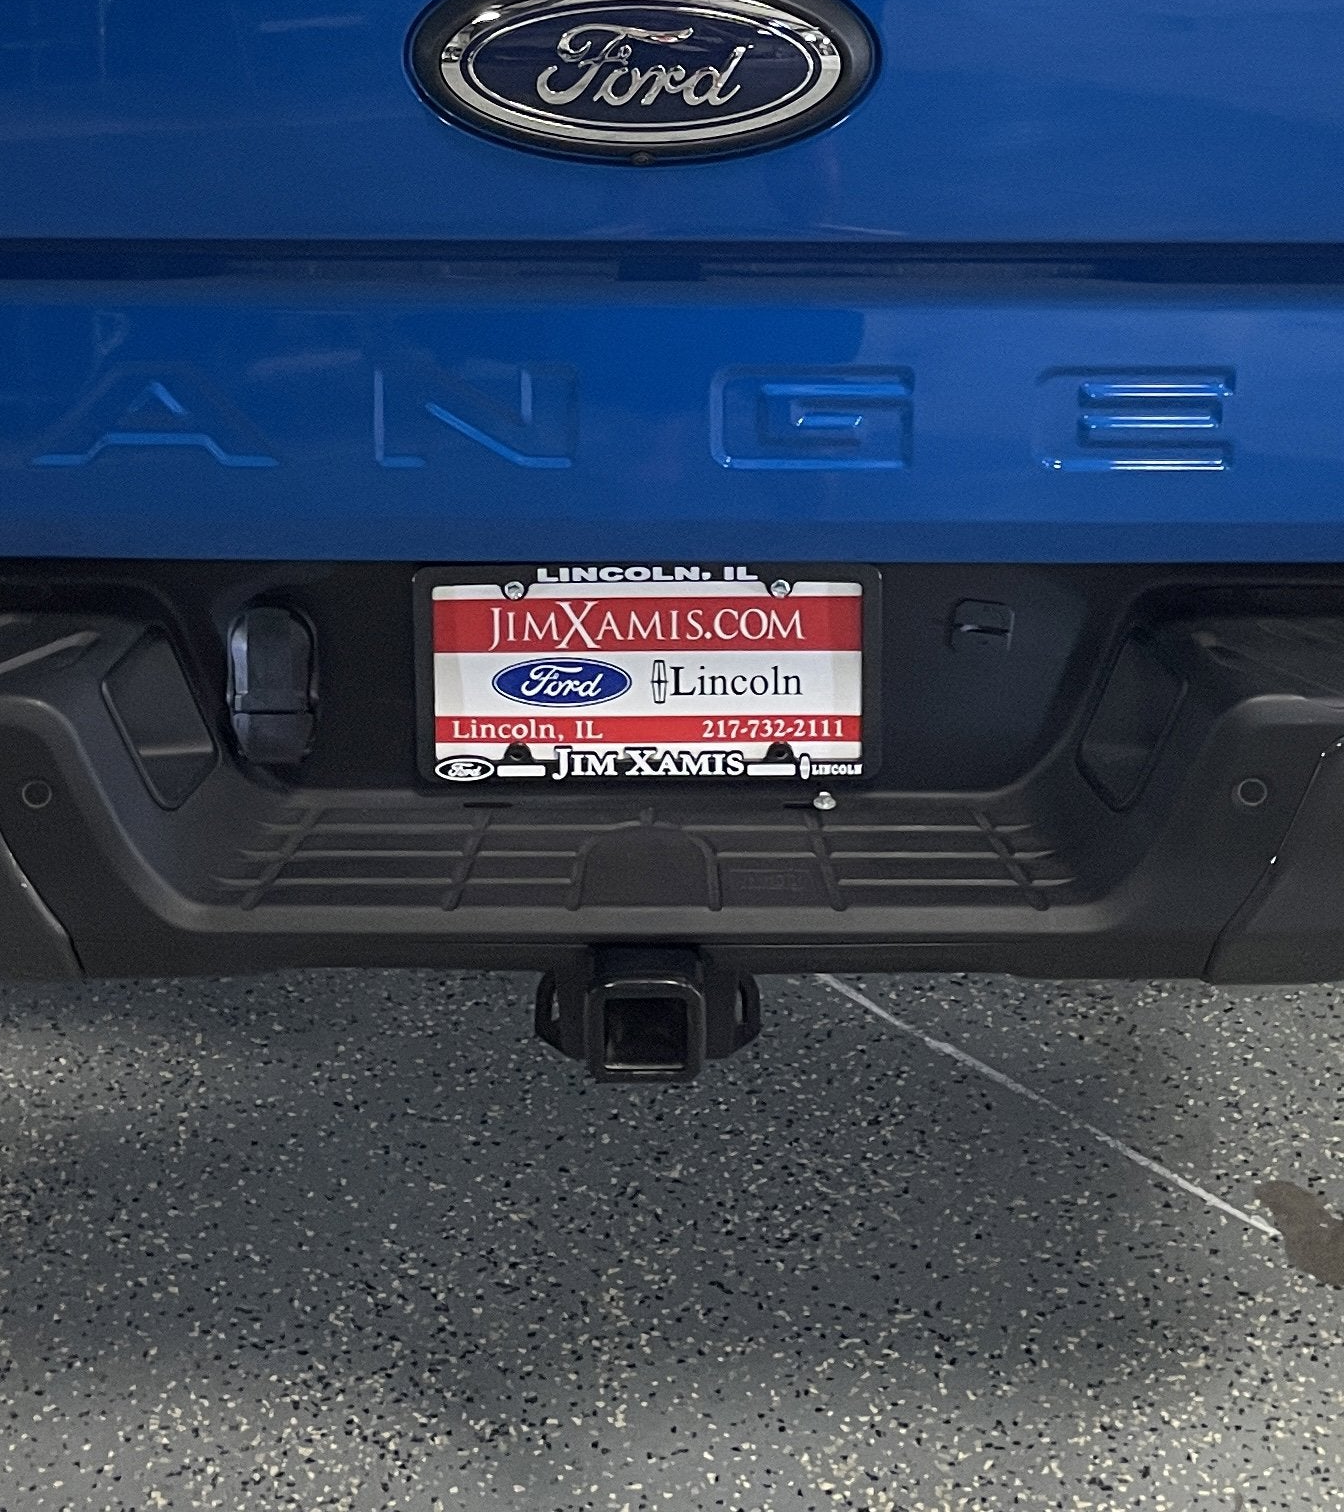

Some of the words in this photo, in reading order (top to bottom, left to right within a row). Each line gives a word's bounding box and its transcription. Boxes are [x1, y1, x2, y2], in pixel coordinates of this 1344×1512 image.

[536, 22, 755, 107] Ford
[724, 566, 759, 582] IL
[488, 600, 806, 651] JIMXAMIS.COM
[520, 664, 603, 697] Ford
[669, 665, 804, 697] Lincoln
[452, 718, 565, 742] Lincoln,
[574, 720, 604, 740] IL
[701, 719, 845, 739] 217-732-2111
[551, 746, 618, 780] JIM
[624, 749, 745, 777] XAMIS
[811, 763, 863, 776] LINCOLN
